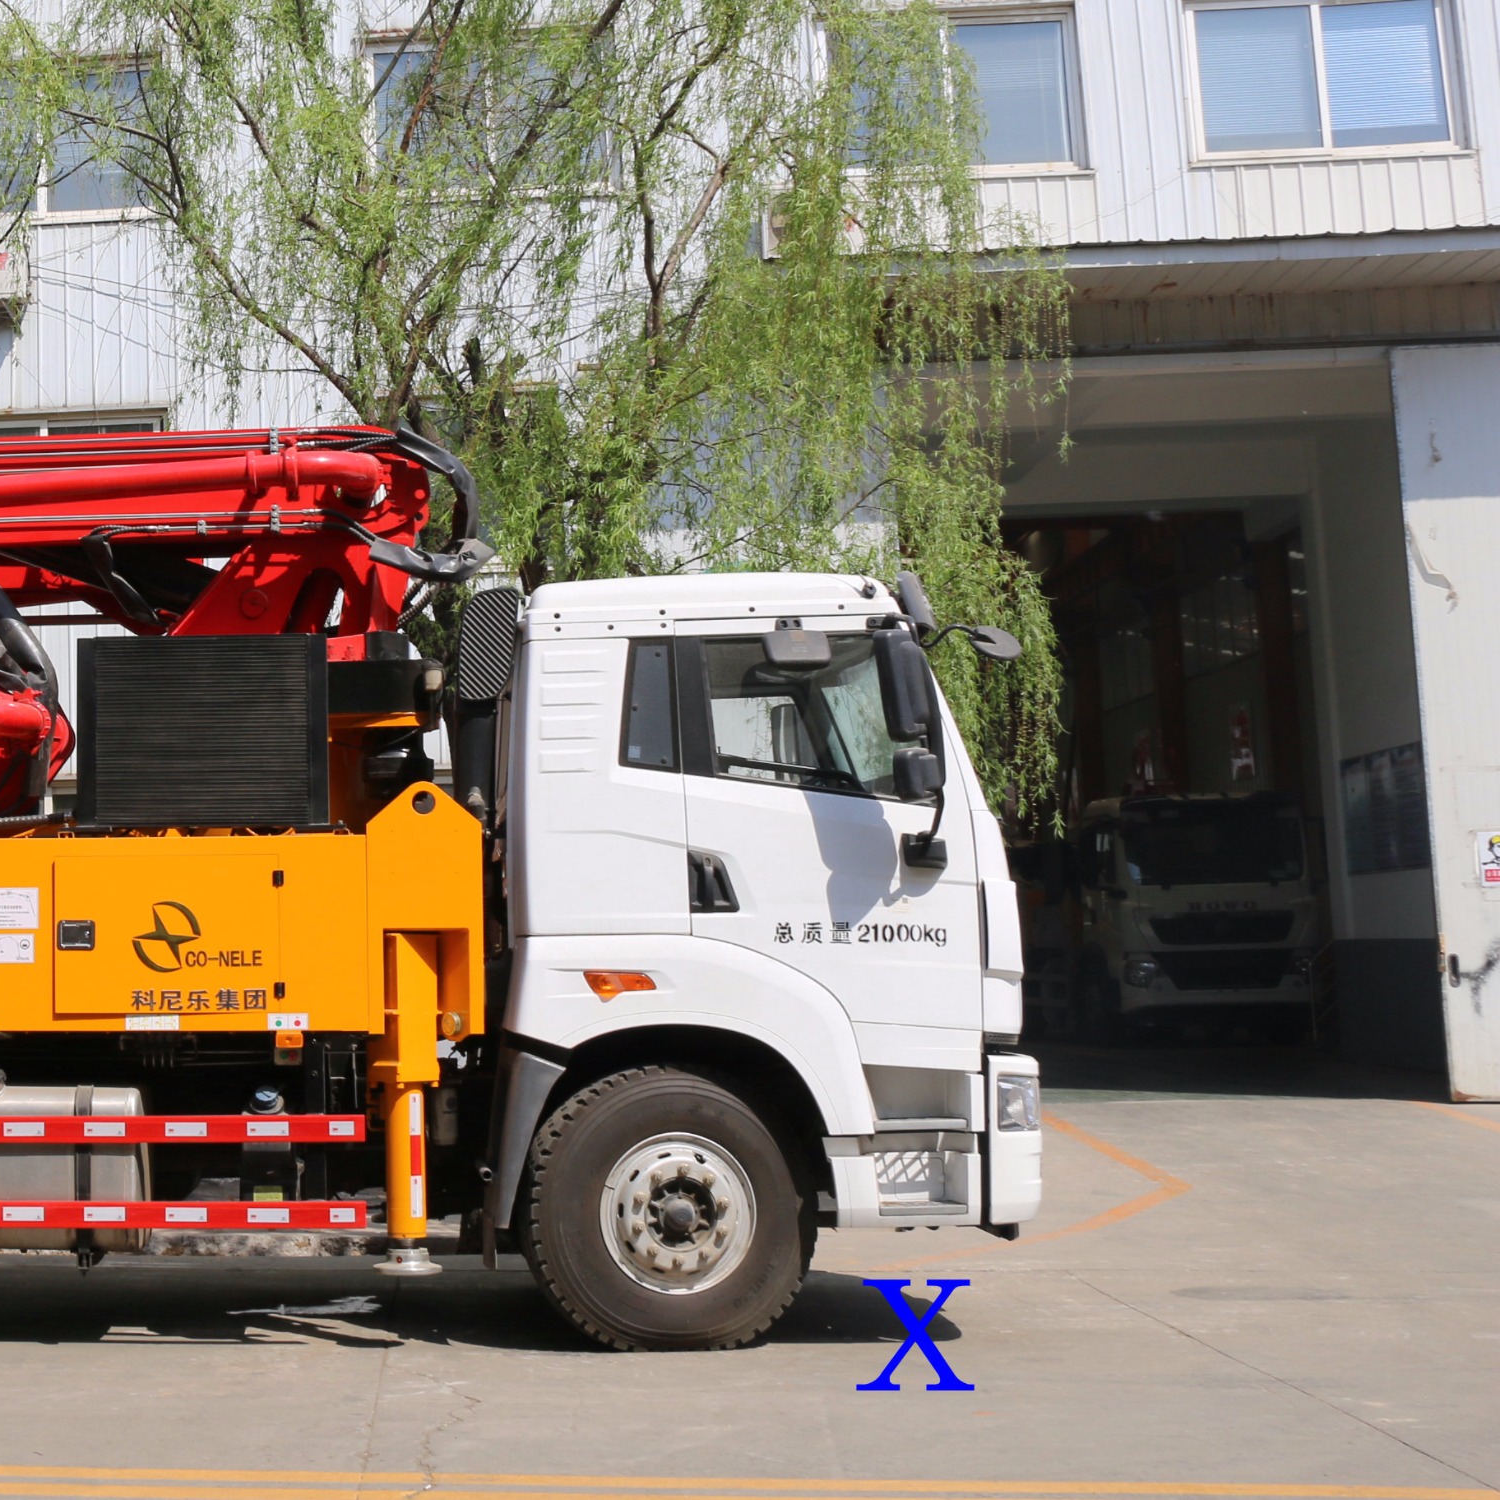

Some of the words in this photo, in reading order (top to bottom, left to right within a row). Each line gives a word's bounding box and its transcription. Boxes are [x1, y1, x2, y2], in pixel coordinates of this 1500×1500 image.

[185, 950, 263, 967] CO-NELE
[131, 989, 267, 1011] 科尼乐集团
